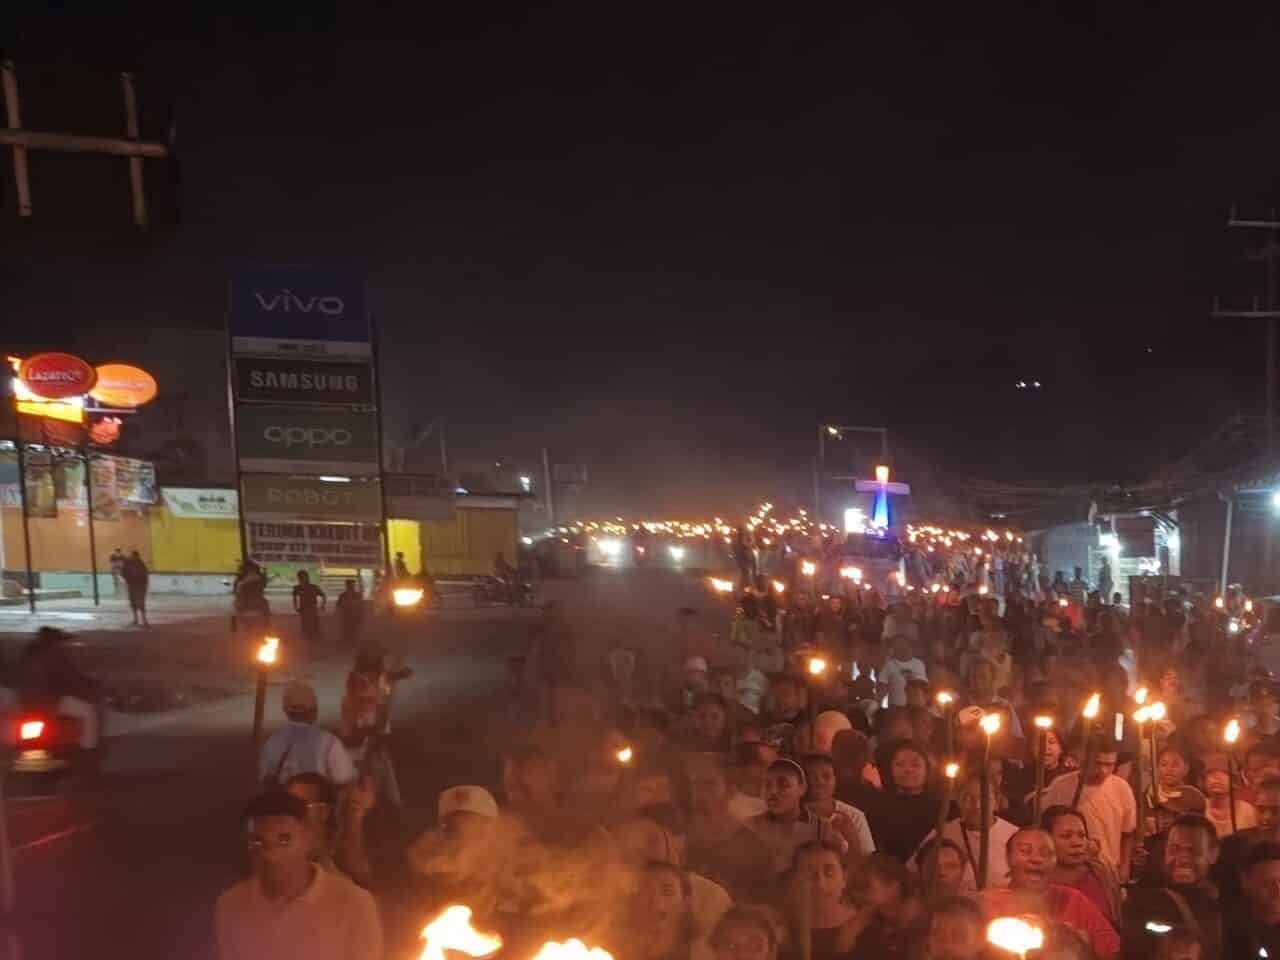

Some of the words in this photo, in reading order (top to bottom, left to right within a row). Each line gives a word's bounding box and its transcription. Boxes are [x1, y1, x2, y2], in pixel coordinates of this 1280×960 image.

[255, 287, 344, 315] vivo
[249, 368, 360, 394] SAMSUNG
[263, 425, 352, 448] oppo
